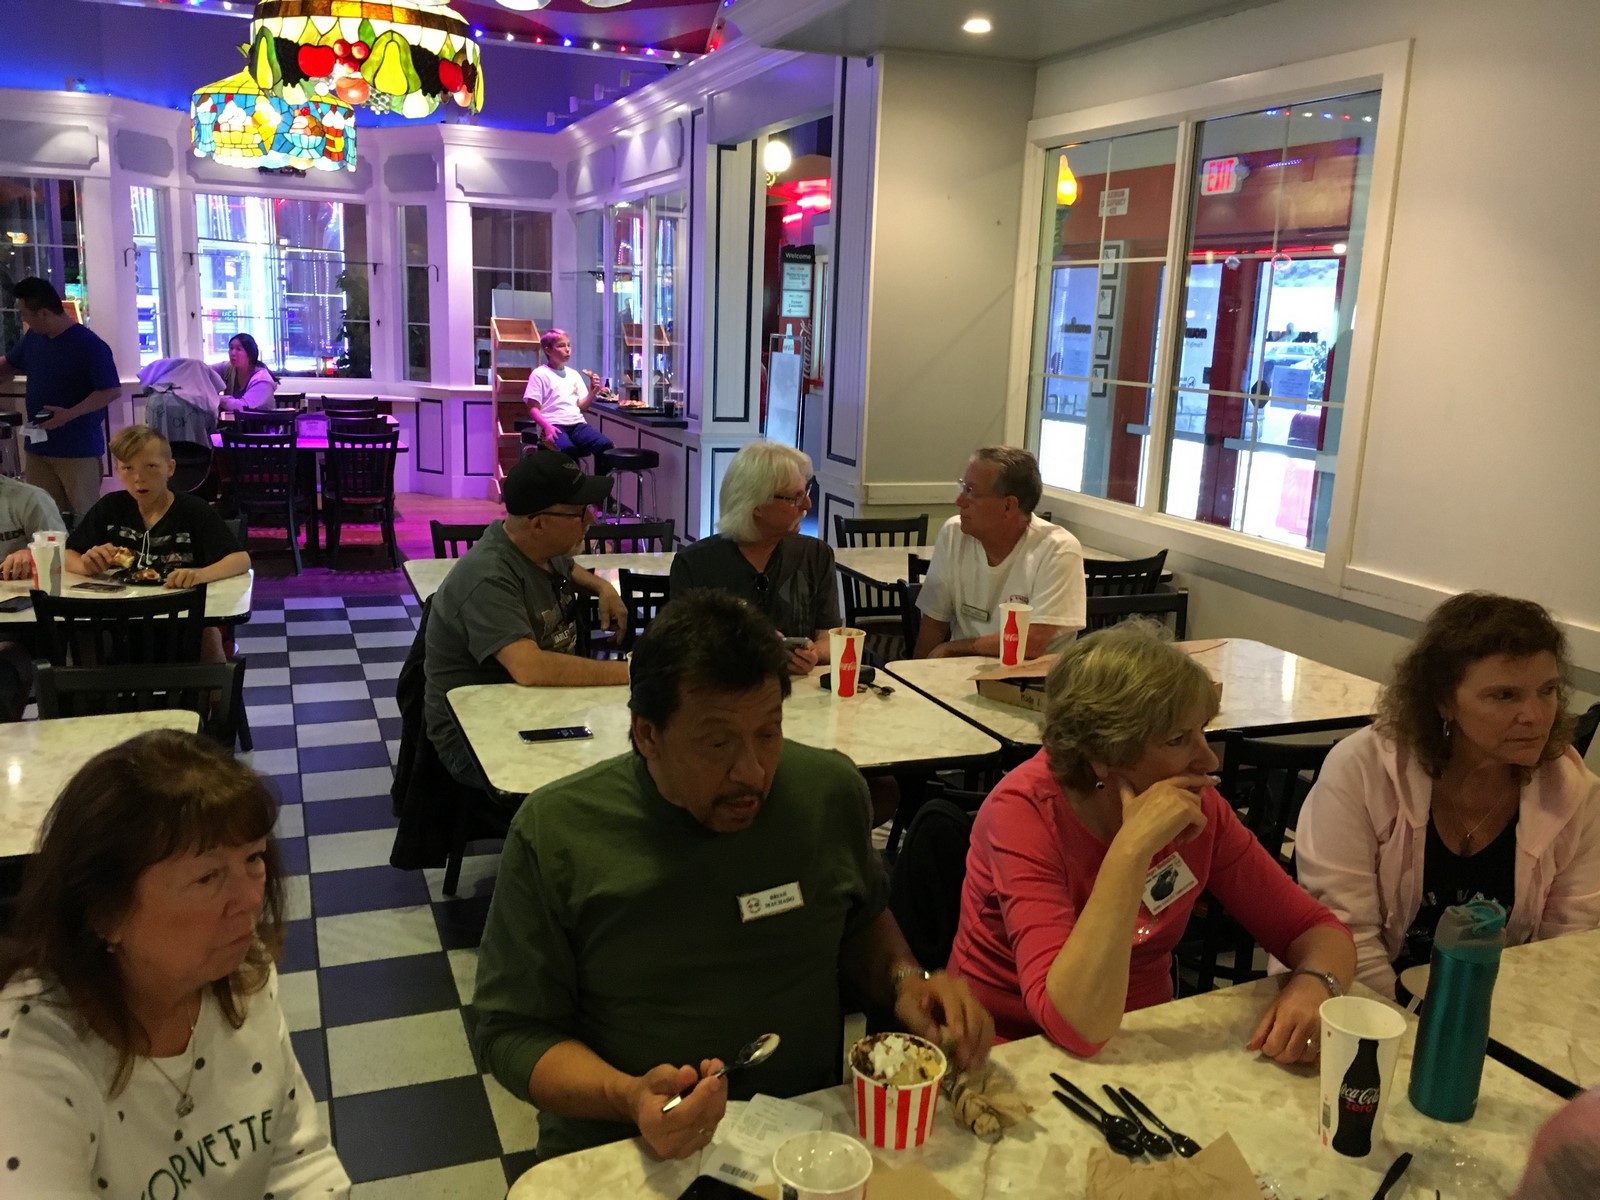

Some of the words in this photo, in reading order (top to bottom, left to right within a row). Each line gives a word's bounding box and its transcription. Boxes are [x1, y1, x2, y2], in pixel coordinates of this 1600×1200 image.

[1206, 159, 1235, 192] EXIT
[785, 252, 812, 260] Welcome
[1344, 1100, 1374, 1113] zero
